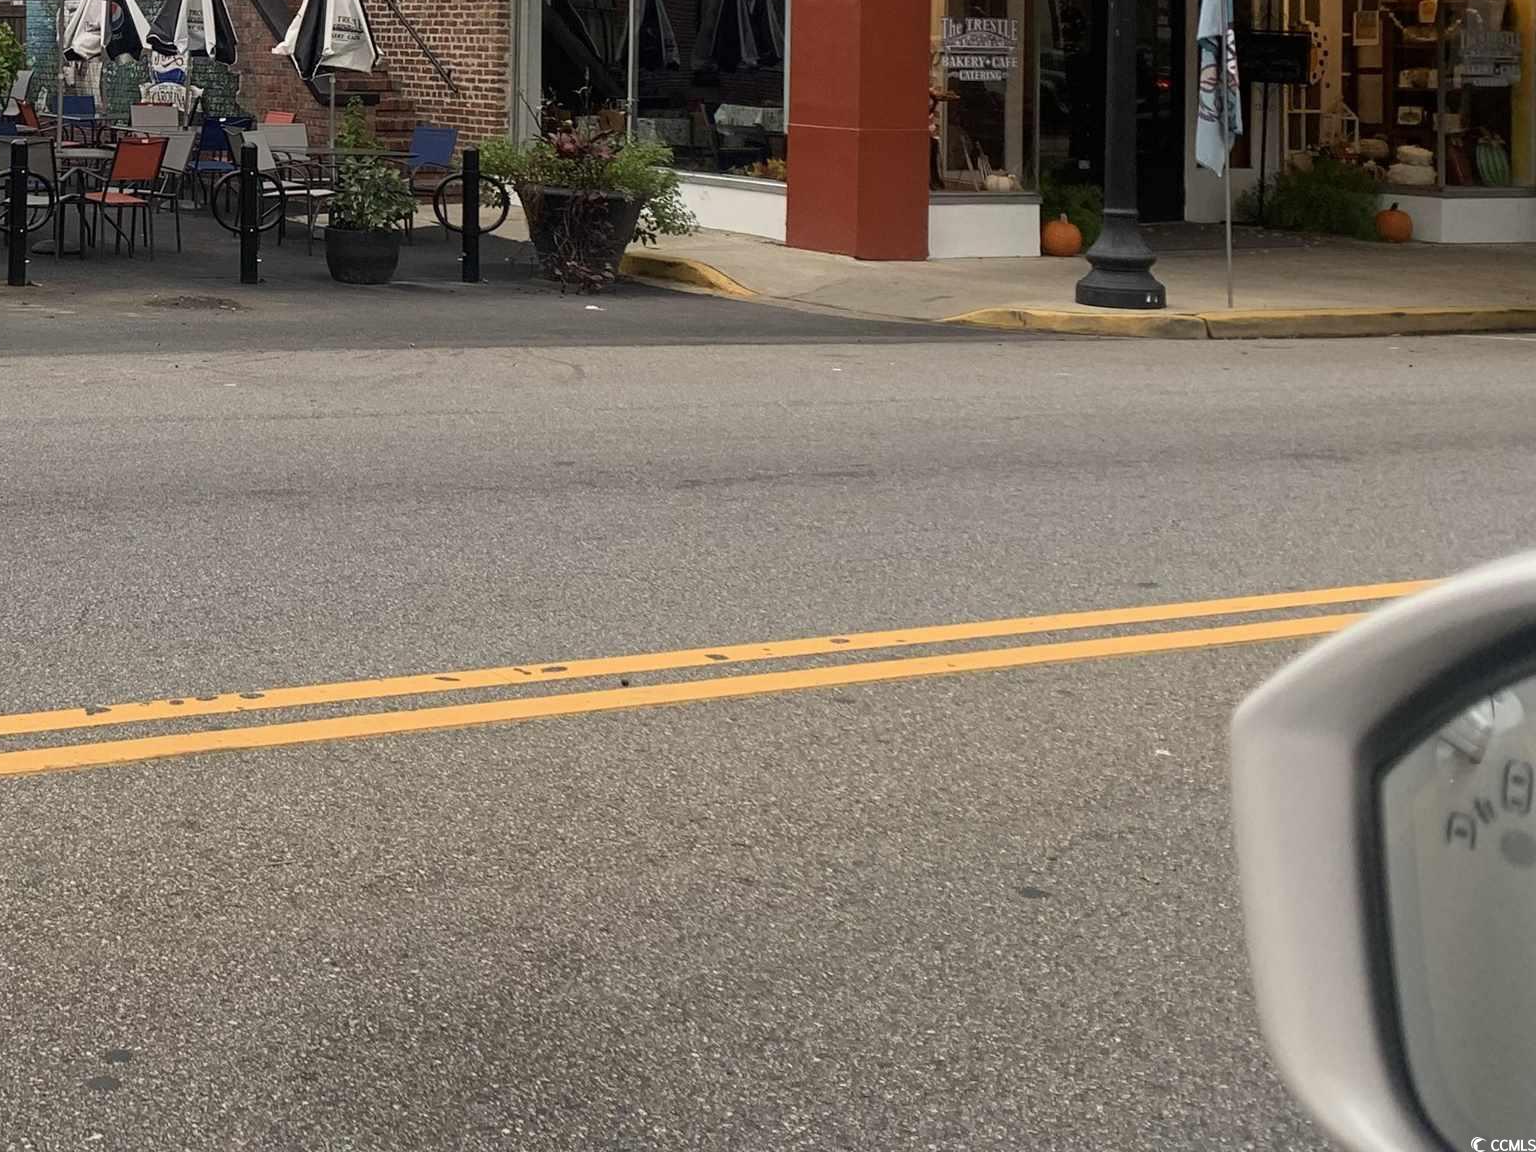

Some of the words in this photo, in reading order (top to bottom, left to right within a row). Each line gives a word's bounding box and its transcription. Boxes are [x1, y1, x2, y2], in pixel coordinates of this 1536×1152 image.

[941, 17, 963, 40] The
[966, 17, 1018, 41] TRESTLE
[992, 55, 1018, 68] CAFE
[960, 70, 1002, 81] CATERING
